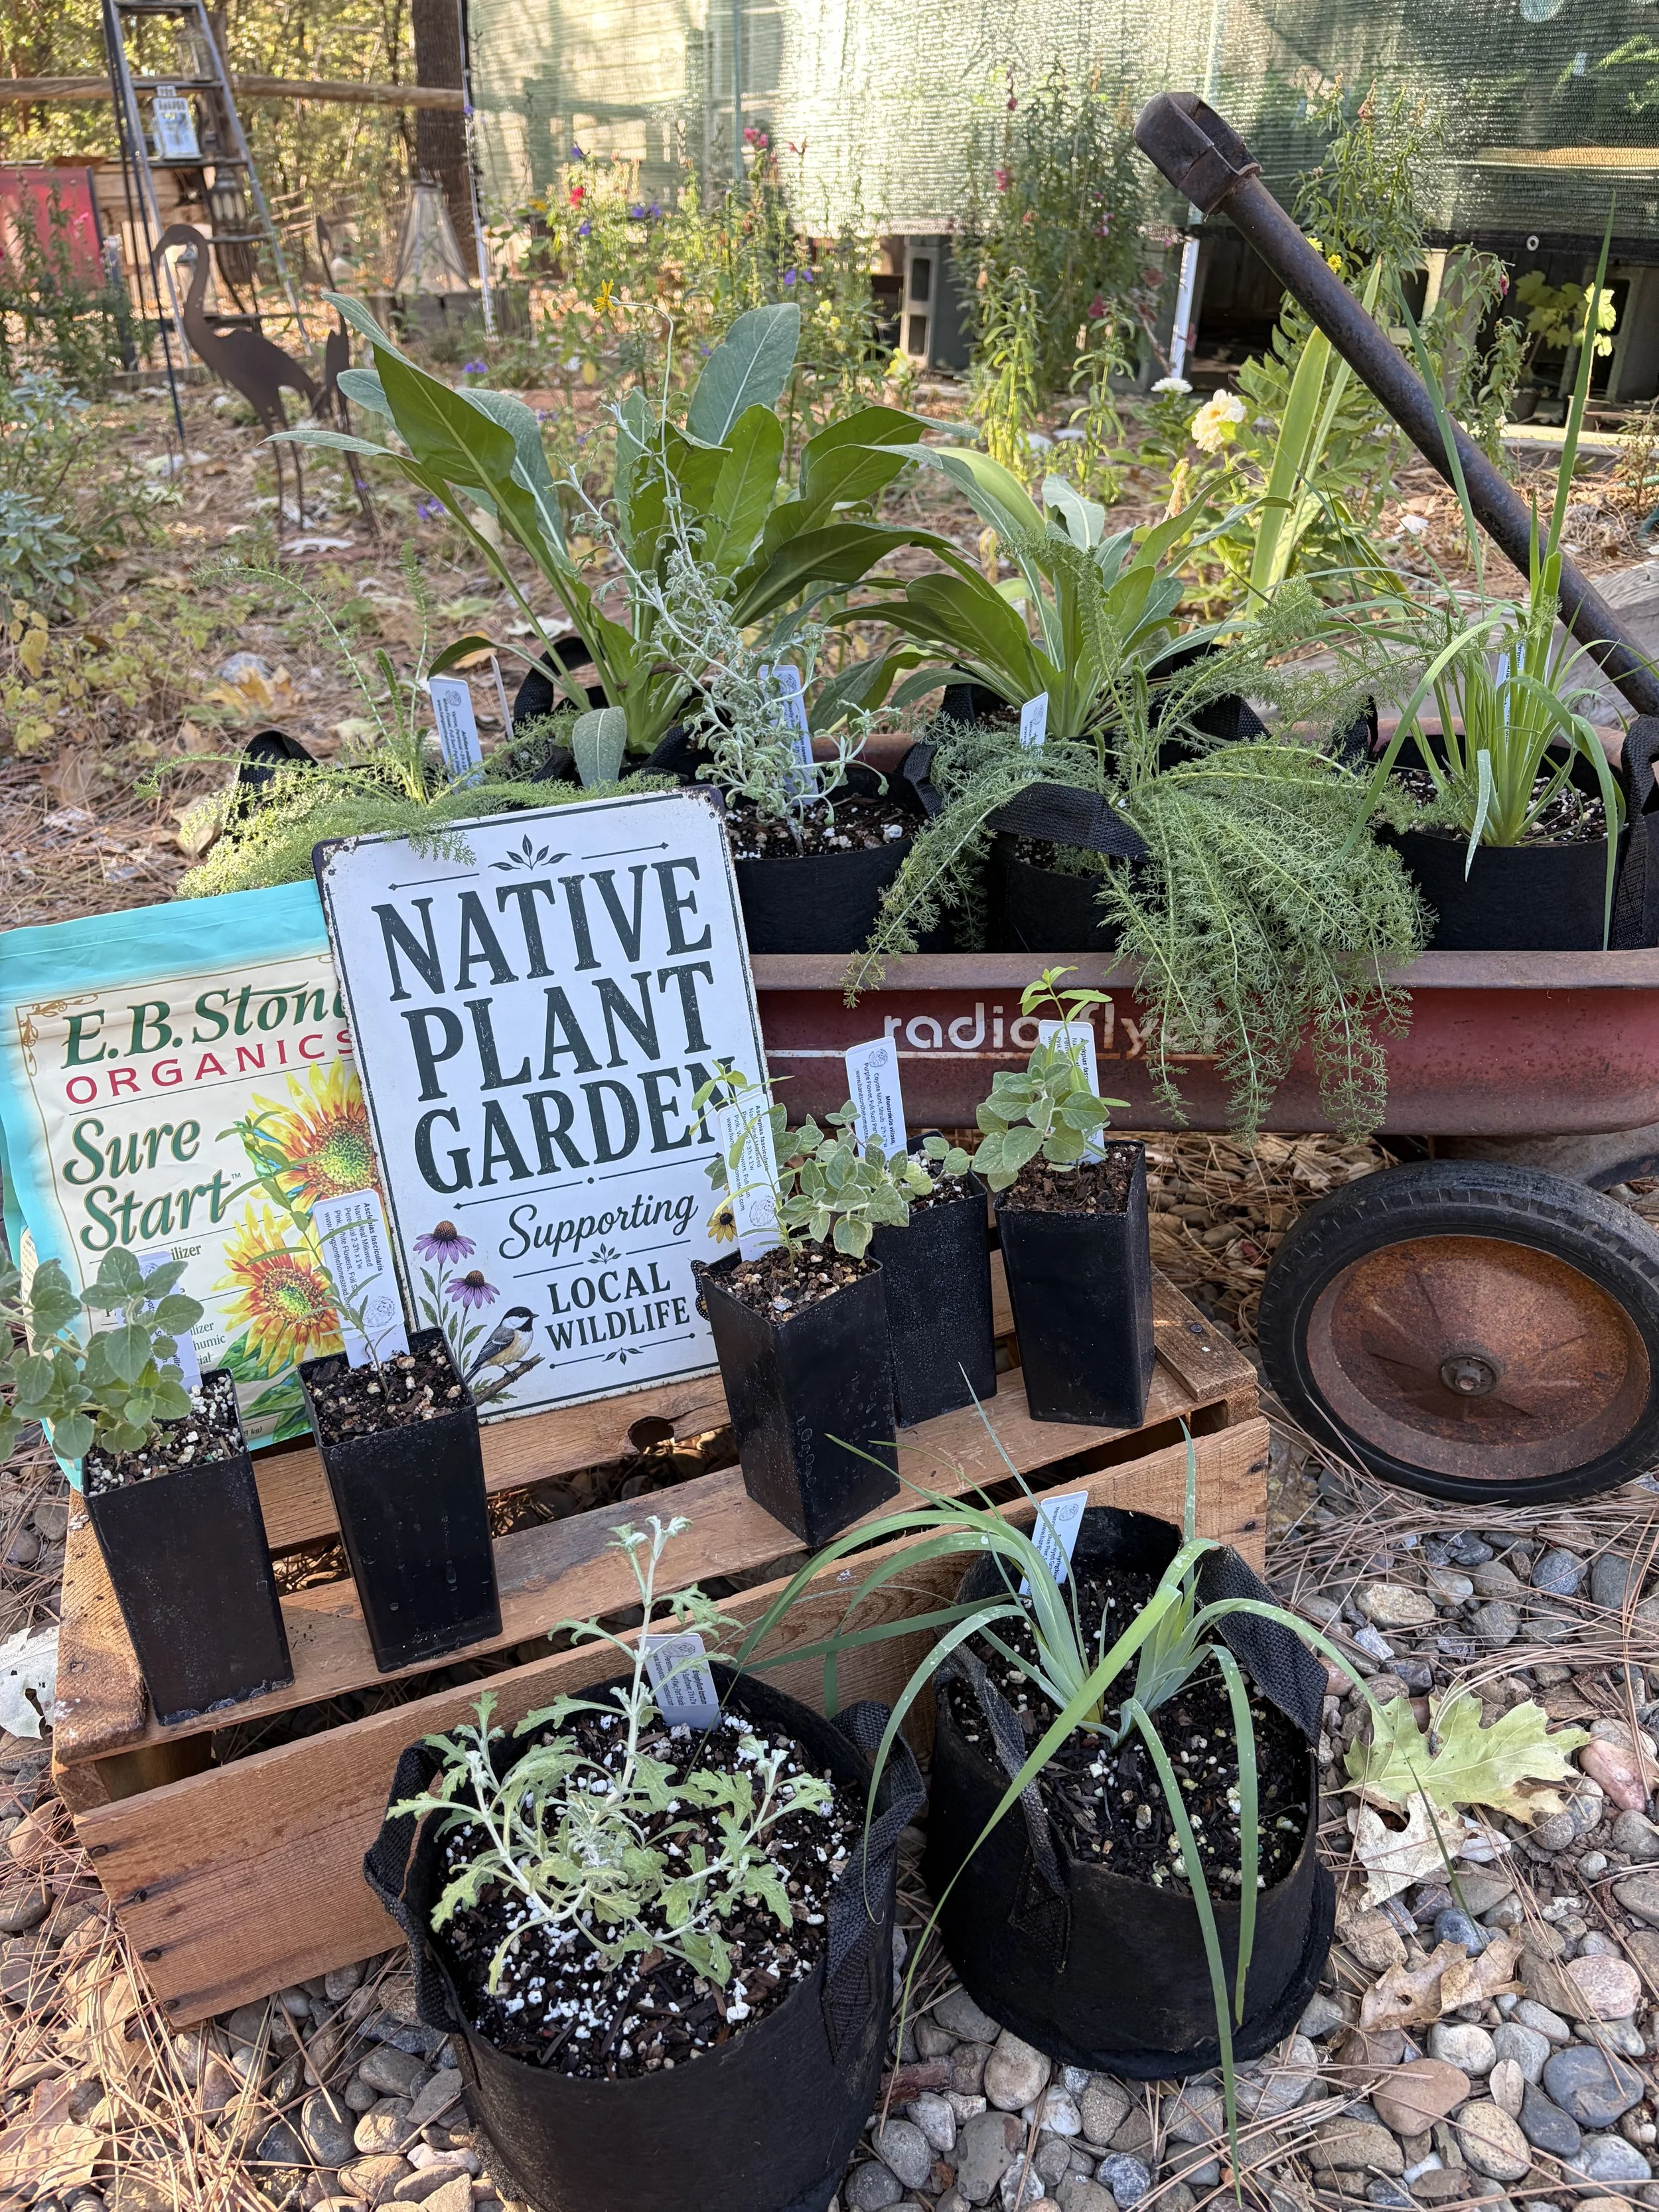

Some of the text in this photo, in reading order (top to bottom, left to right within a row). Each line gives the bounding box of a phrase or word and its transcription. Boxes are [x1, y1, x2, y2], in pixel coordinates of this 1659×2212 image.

[371, 857, 713, 1001] NATIVE
[60, 1000, 183, 1069] E.B.
[400, 961, 714, 1102] PLANT
[884, 1002, 1040, 1049] radio
[66, 1029, 354, 1104] ORGANICS
[415, 1057, 735, 1194] GARDEN
[884, 1096, 893, 1126] Monardella
[62, 1118, 200, 1185] Sure
[80, 1169, 231, 1251] Start
[498, 1195, 698, 1259] Supporting
[171, 1245, 202, 1261] ilizer
[334, 1210, 343, 1226] Pink,
[342, 1245, 352, 1272] Flowers,
[348, 1272, 356, 1283] Full
[361, 1239, 373, 1267] Milkweed
[370, 1235, 384, 1271] fascicularis
[547, 1262, 671, 1315] LOCAL
[190, 1322, 214, 1336] ilizer
[193, 1335, 226, 1351] humic
[545, 1296, 690, 1351] WILDLIFE
